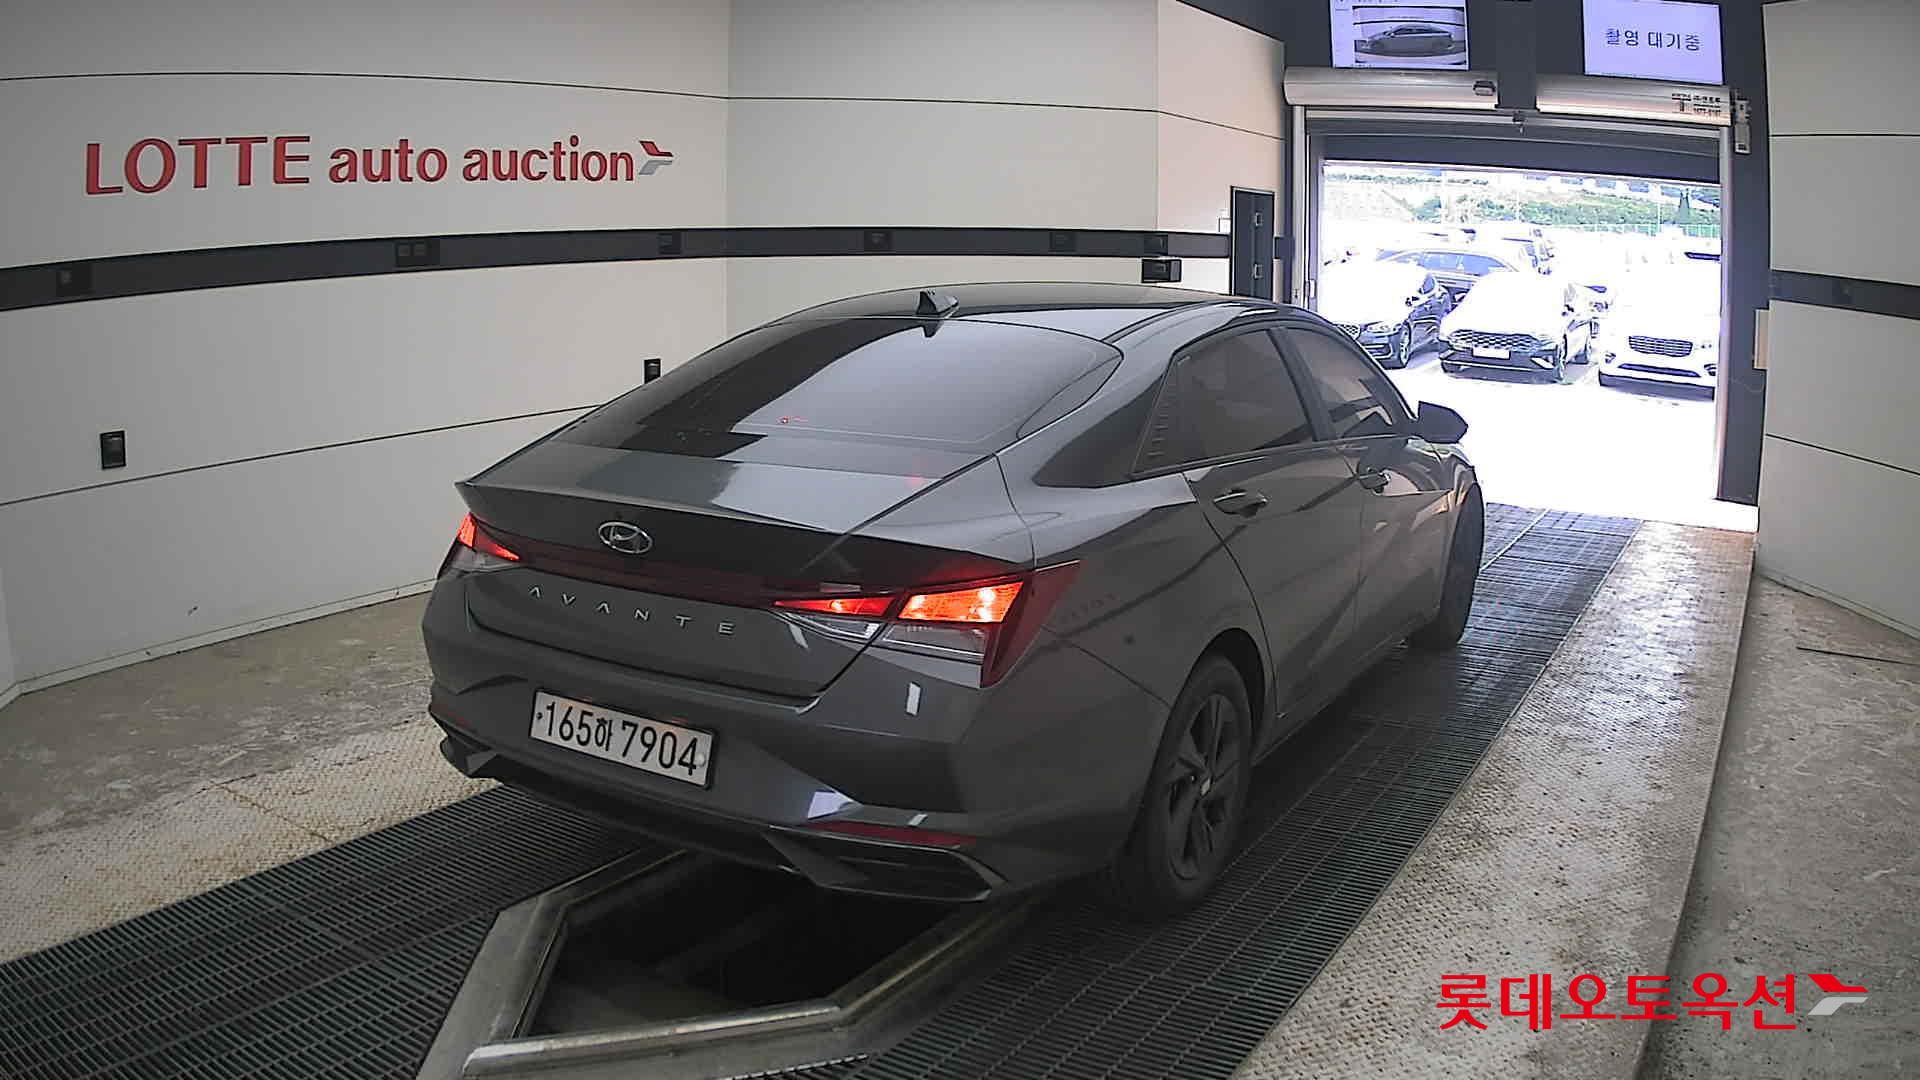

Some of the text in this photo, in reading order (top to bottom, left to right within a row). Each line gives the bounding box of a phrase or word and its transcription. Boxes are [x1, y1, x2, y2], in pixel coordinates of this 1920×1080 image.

[85, 135, 634, 195] LOTTE auto auction
[529, 585, 735, 635] AVANTE
